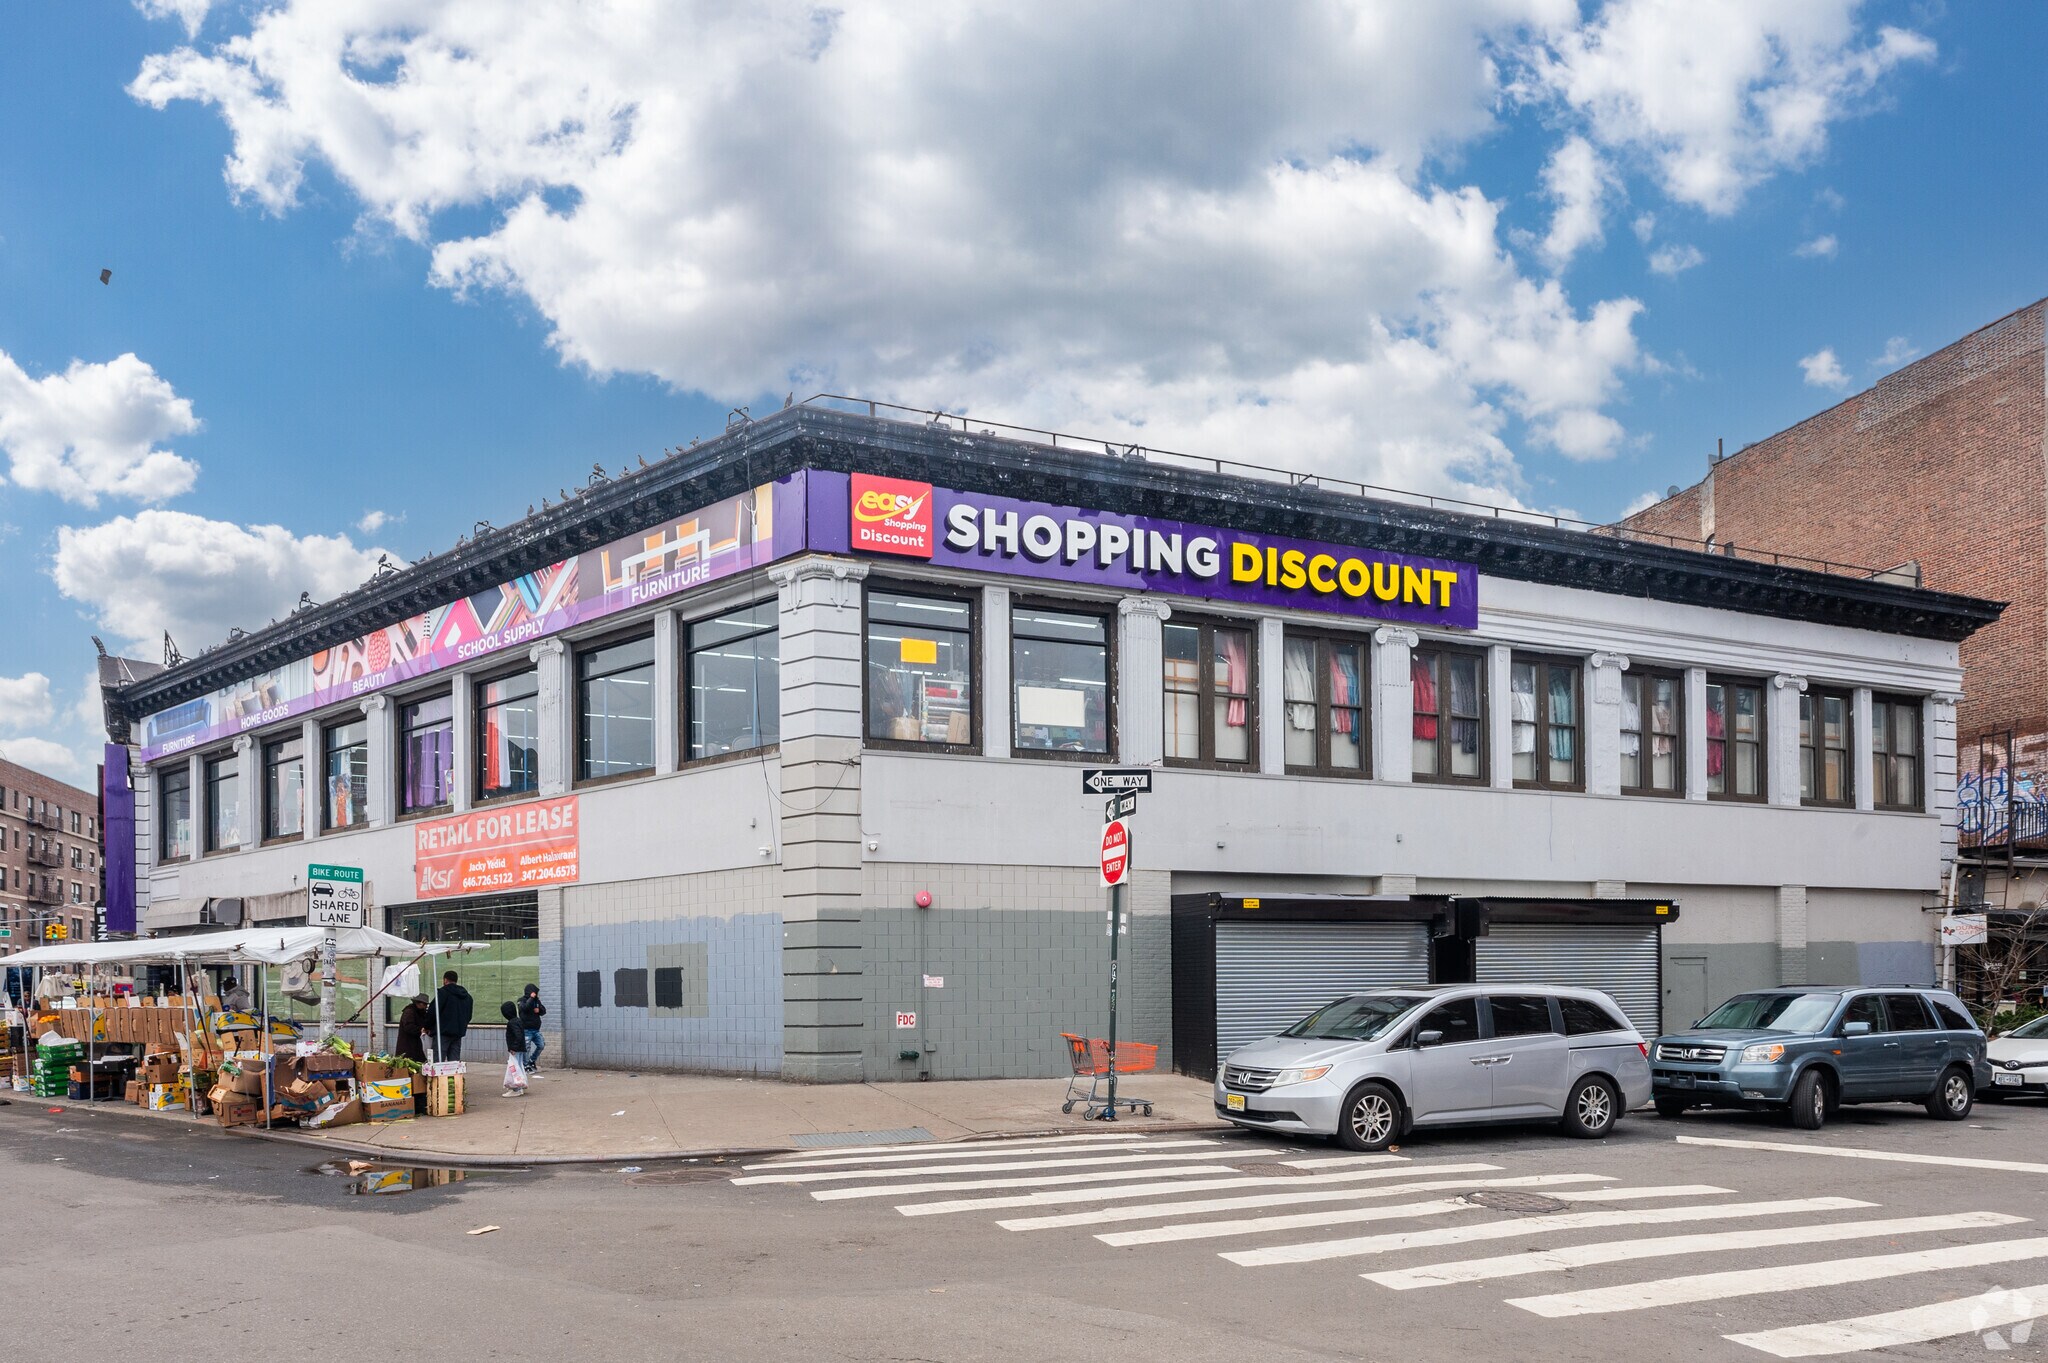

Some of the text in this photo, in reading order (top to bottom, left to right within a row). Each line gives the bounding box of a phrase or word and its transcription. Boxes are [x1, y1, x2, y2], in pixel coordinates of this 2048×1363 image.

[861, 490, 924, 521] easy
[884, 518, 927, 533] Shopping
[860, 528, 924, 548] Discount
[945, 503, 1458, 607] SHOPPING DISCOUNT
[631, 562, 711, 602] FURNITURE
[457, 618, 545, 659] SCHOOL SUPPLY
[352, 671, 387, 694] BEAUTY
[240, 704, 289, 729] HOME GOODS
[162, 734, 196, 754] FURNITURE
[1093, 776, 1144, 787] ONE WAY
[418, 804, 573, 850] RETAIL FOR LEASE
[1105, 831, 1124, 847] DO NOT
[469, 861, 487, 872] Jacky
[520, 854, 542, 866] Albert
[1105, 860, 1122, 875] ENTER
[312, 867, 360, 880] BIKE ROUTE
[312, 899, 359, 912] SHARED
[320, 912, 351, 924] LANE
[897, 1014, 915, 1026] FDC
